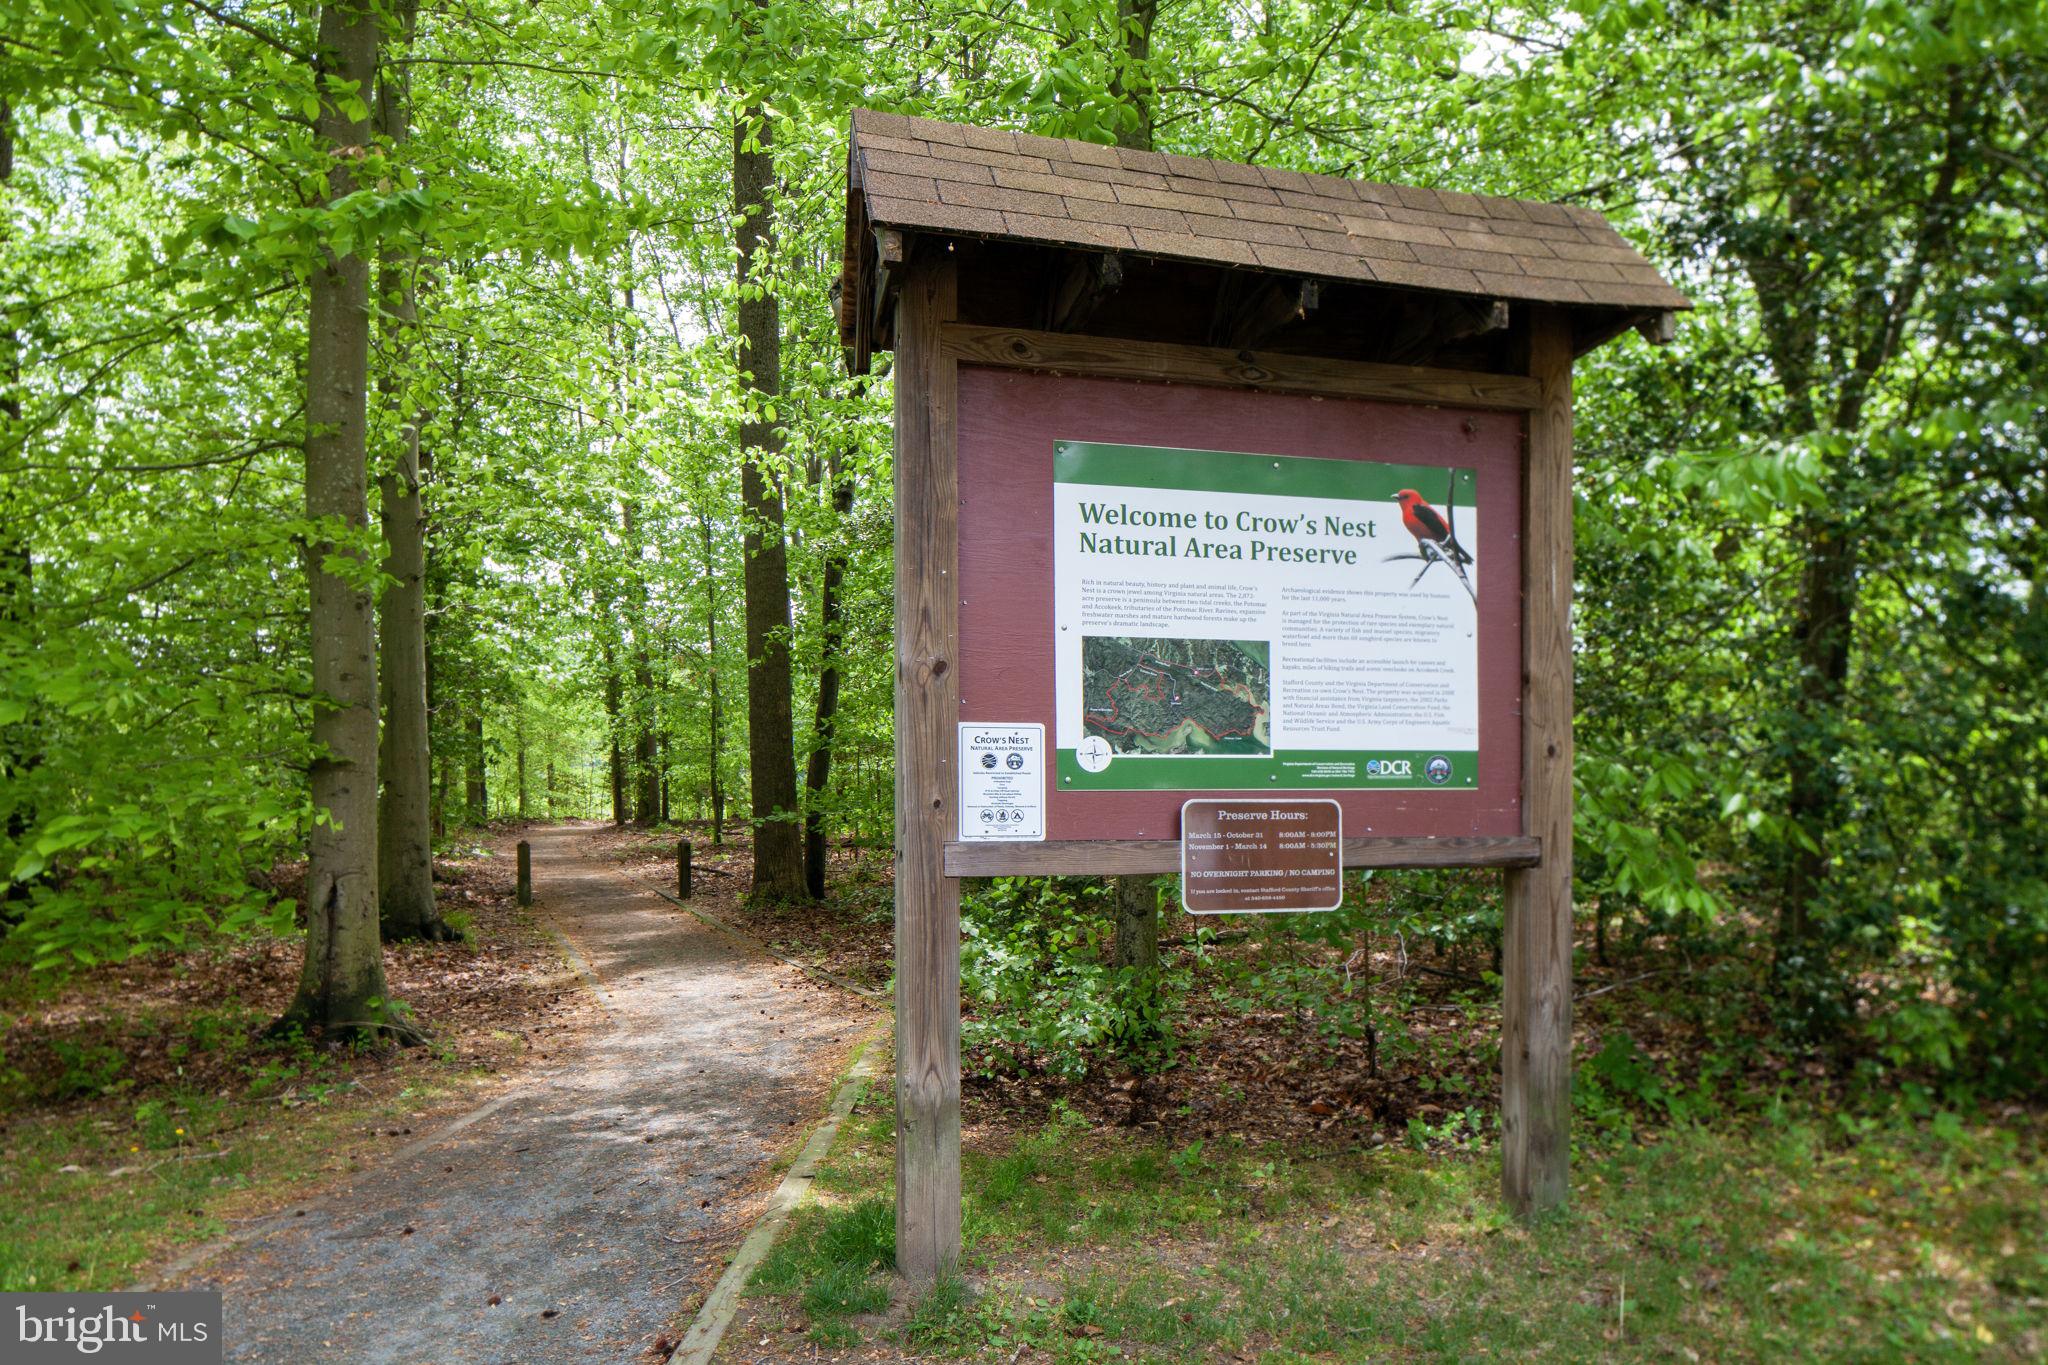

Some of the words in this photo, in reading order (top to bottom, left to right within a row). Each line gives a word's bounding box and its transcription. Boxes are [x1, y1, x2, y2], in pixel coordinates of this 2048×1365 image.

[1079, 502, 1197, 528] Welcome
[1205, 510, 1228, 530] to
[1236, 511, 1317, 535] Crow's
[1325, 516, 1376, 538] Nest
[1080, 532, 1176, 557] Natural
[1184, 537, 1242, 560] Area
[1250, 541, 1356, 565] Preserve
[975, 736, 1006, 744] CROW'S
[1009, 736, 1029, 744] NEST
[1380, 760, 1411, 775] DCR
[1218, 811, 1267, 820] Preserve
[1271, 810, 1309, 820] Hours:
